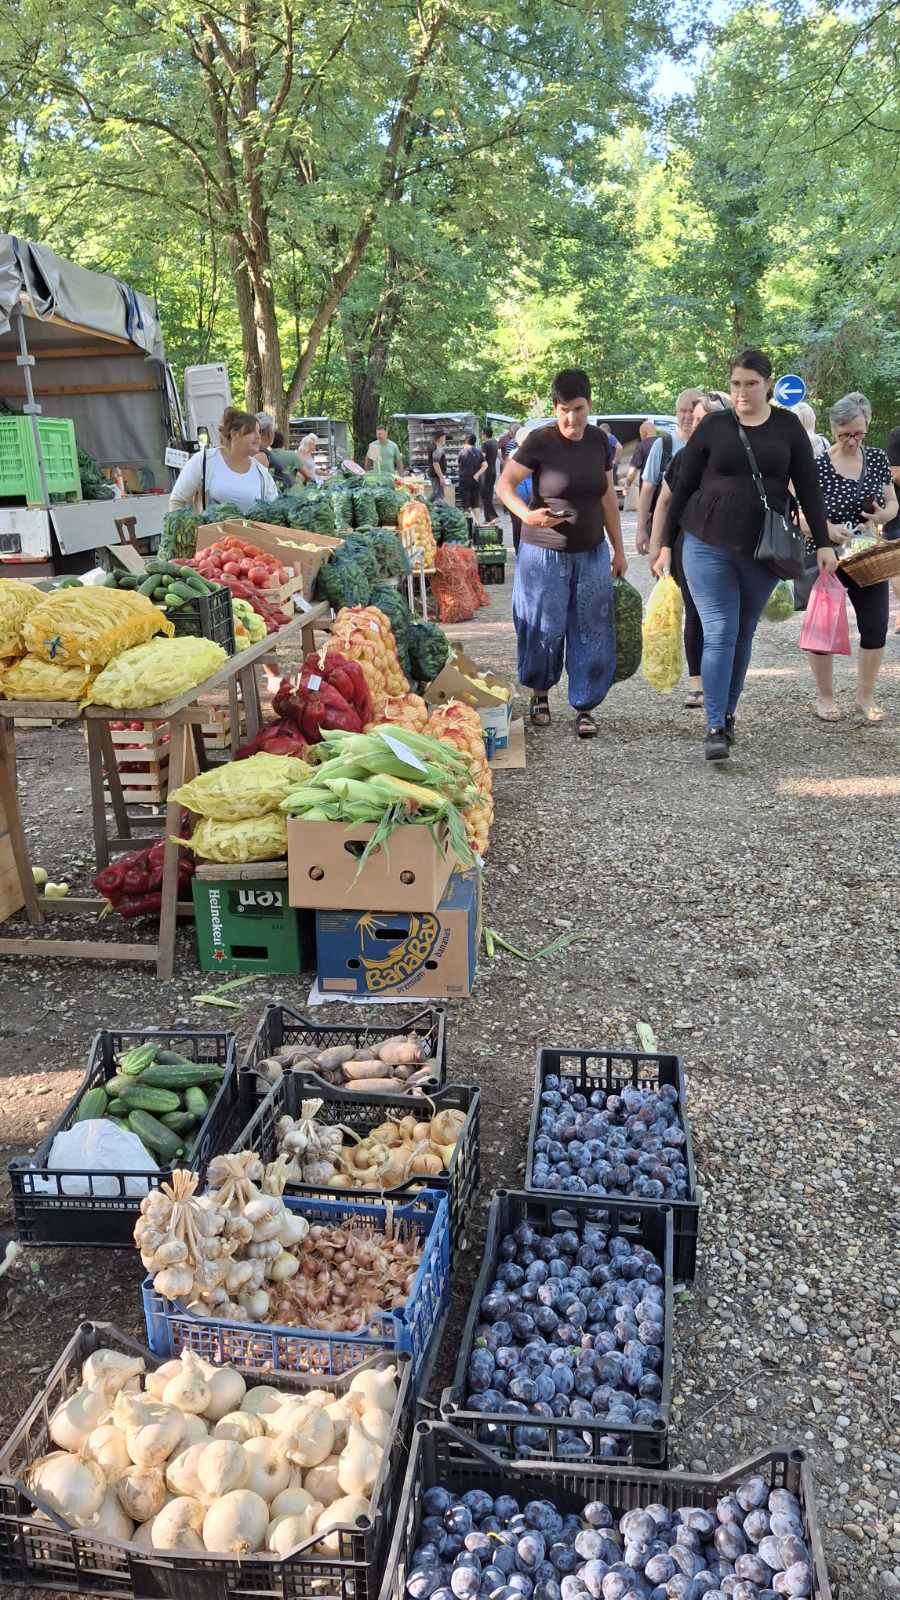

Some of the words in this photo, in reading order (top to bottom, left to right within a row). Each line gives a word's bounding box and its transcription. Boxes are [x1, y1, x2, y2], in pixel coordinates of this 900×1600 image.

[208, 889, 223, 946] Heineken
[435, 928, 451, 958] bananas
[365, 914, 437, 991] BanaBay
